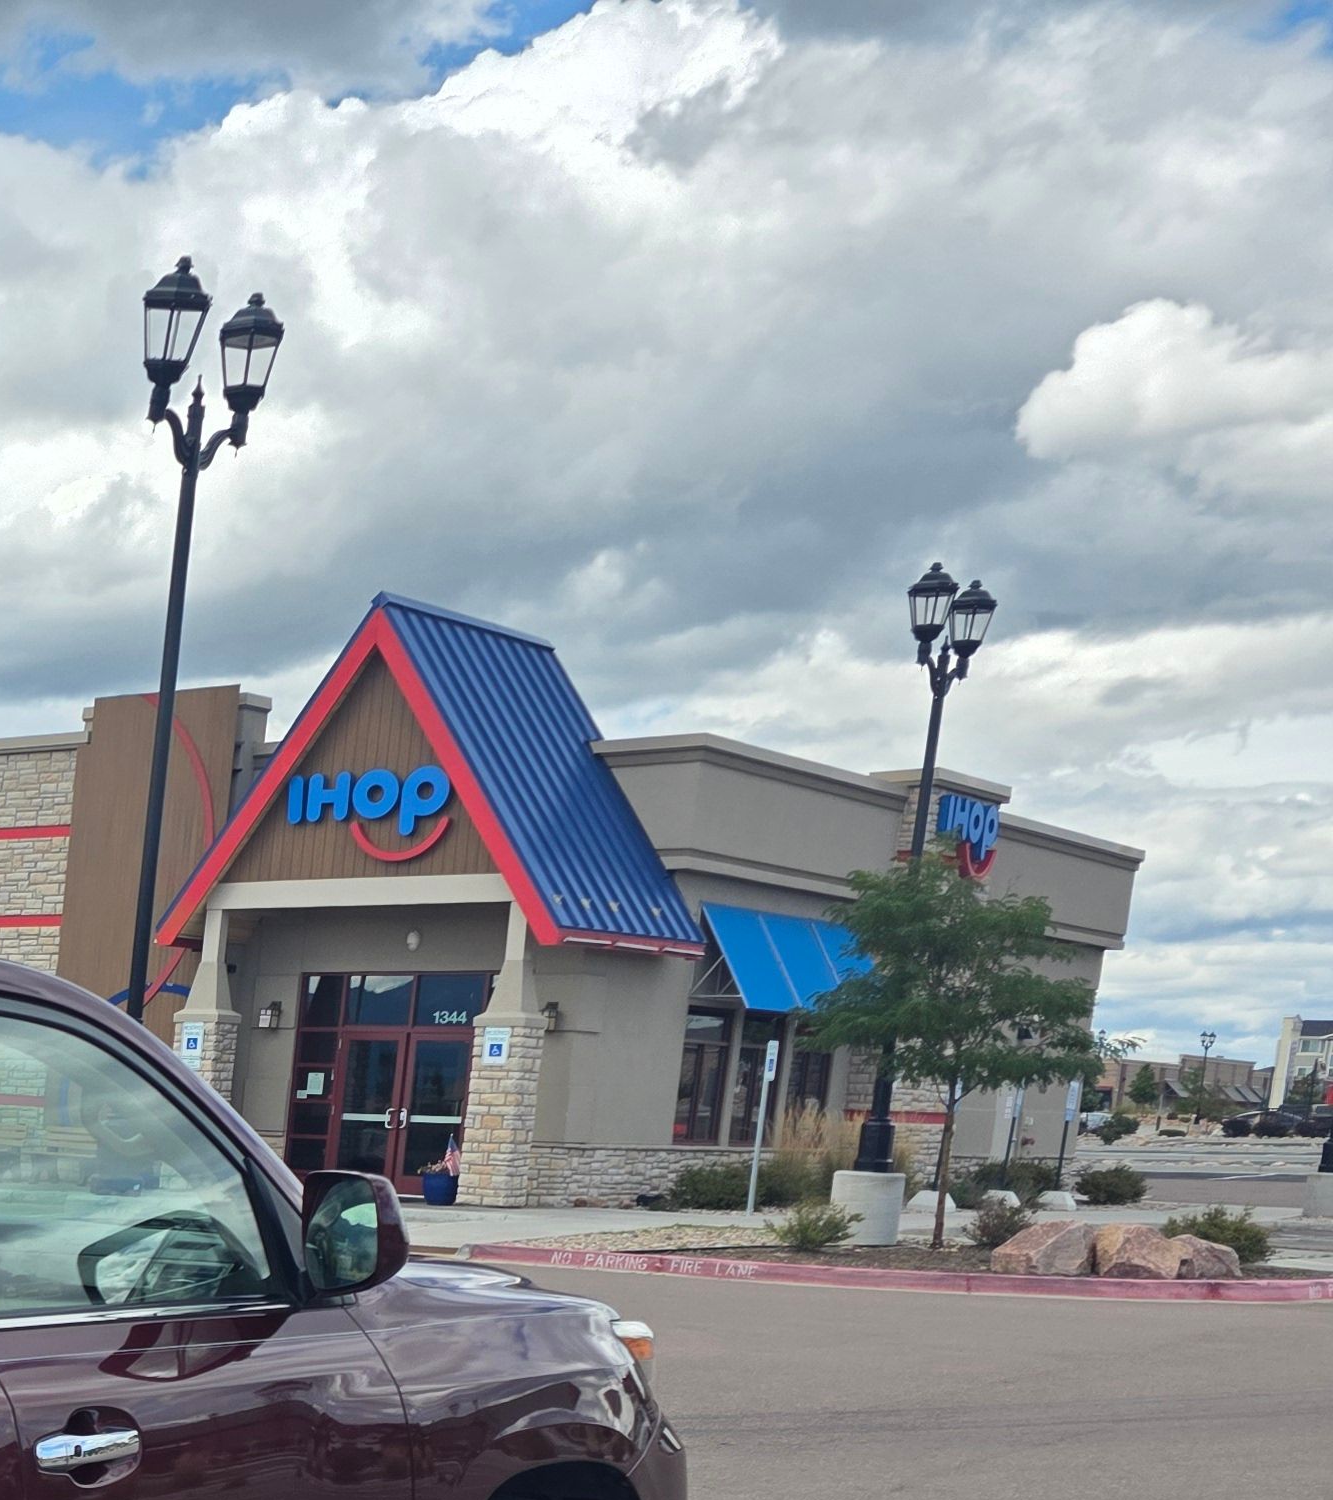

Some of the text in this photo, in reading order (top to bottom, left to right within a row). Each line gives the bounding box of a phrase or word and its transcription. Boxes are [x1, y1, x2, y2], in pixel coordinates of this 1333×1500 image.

[286, 764, 450, 837] IHOP
[944, 794, 1000, 861] IHOP
[433, 1010, 468, 1024] 1344
[550, 1251, 759, 1279] NO PARKING FIRE LANE
